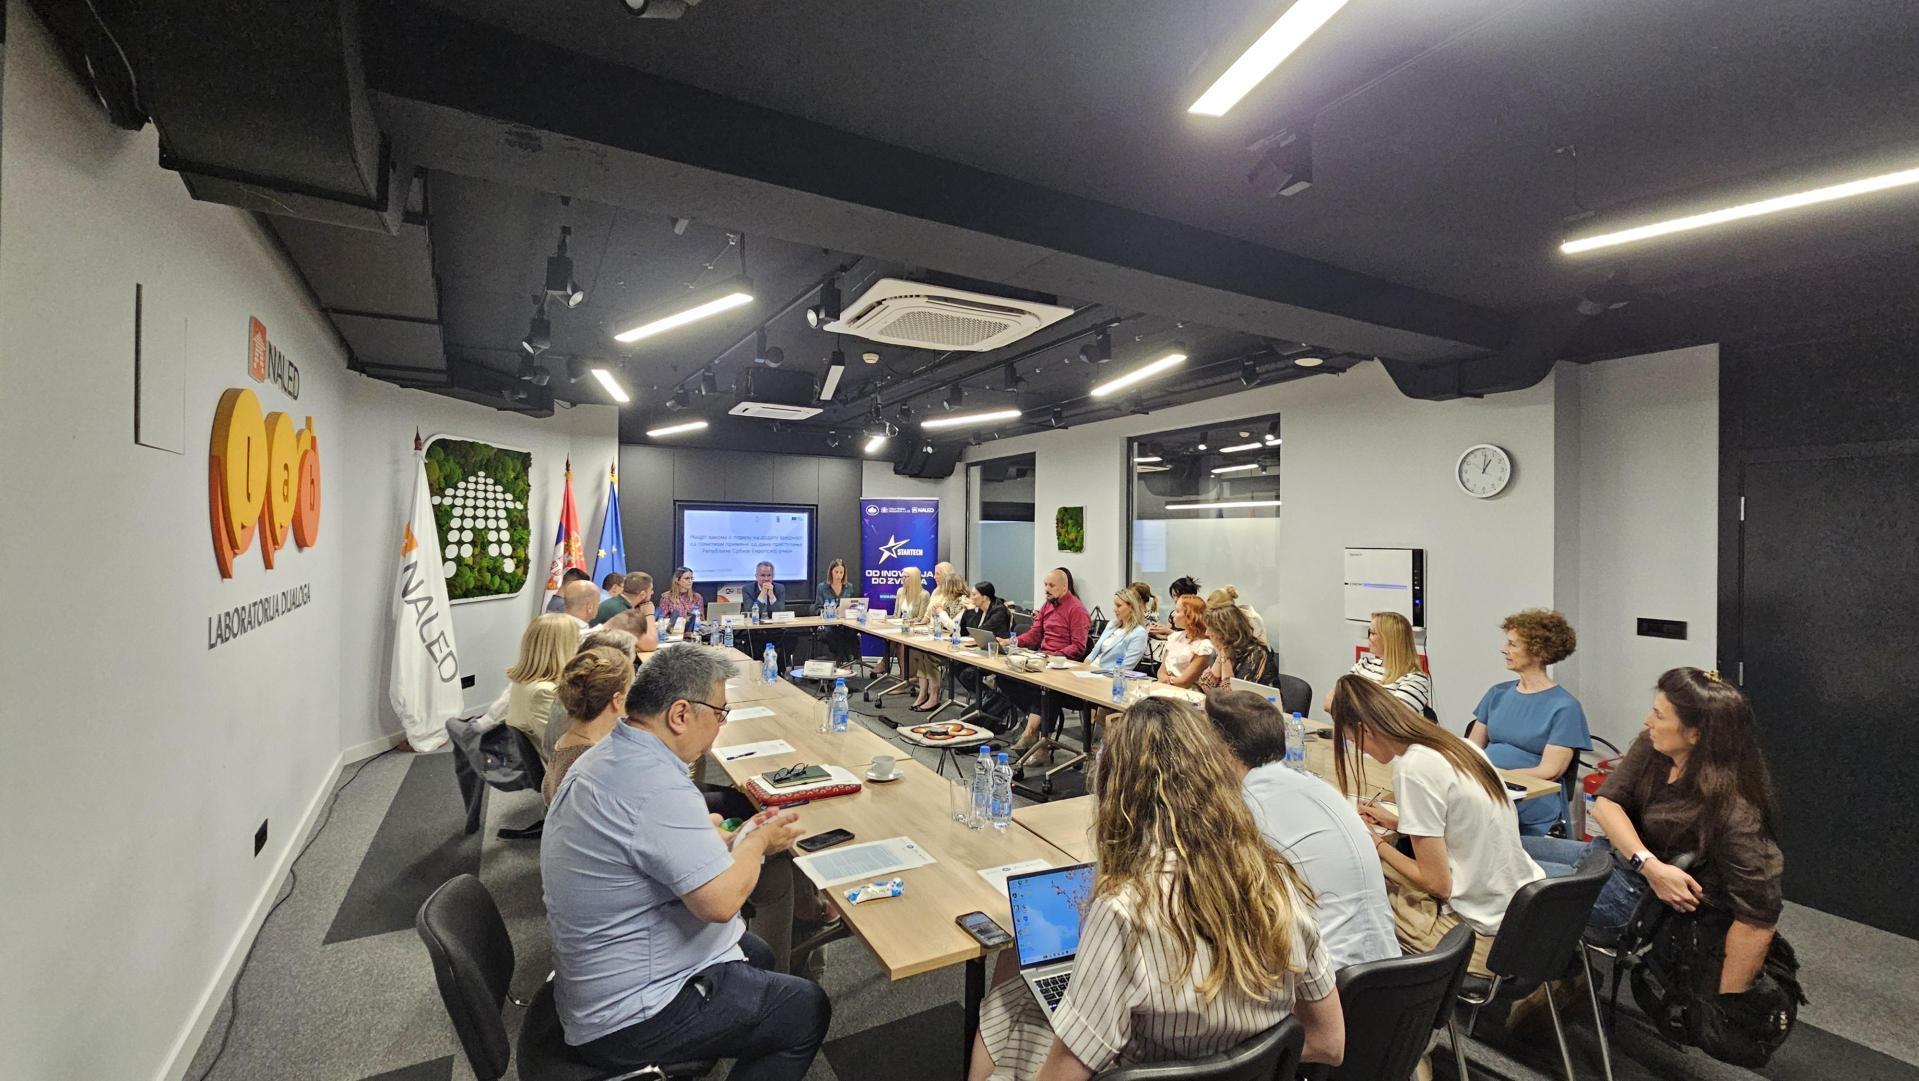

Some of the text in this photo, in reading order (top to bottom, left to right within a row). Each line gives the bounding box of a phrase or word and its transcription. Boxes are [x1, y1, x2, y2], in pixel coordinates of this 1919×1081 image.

[268, 341, 300, 400] NALED
[897, 548, 924, 556] STARTECH
[865, 569, 880, 577] OD
[871, 577, 886, 585] DO
[208, 583, 311, 650] LABORATORIJA DIJALOGA
[401, 559, 458, 684] NALED
